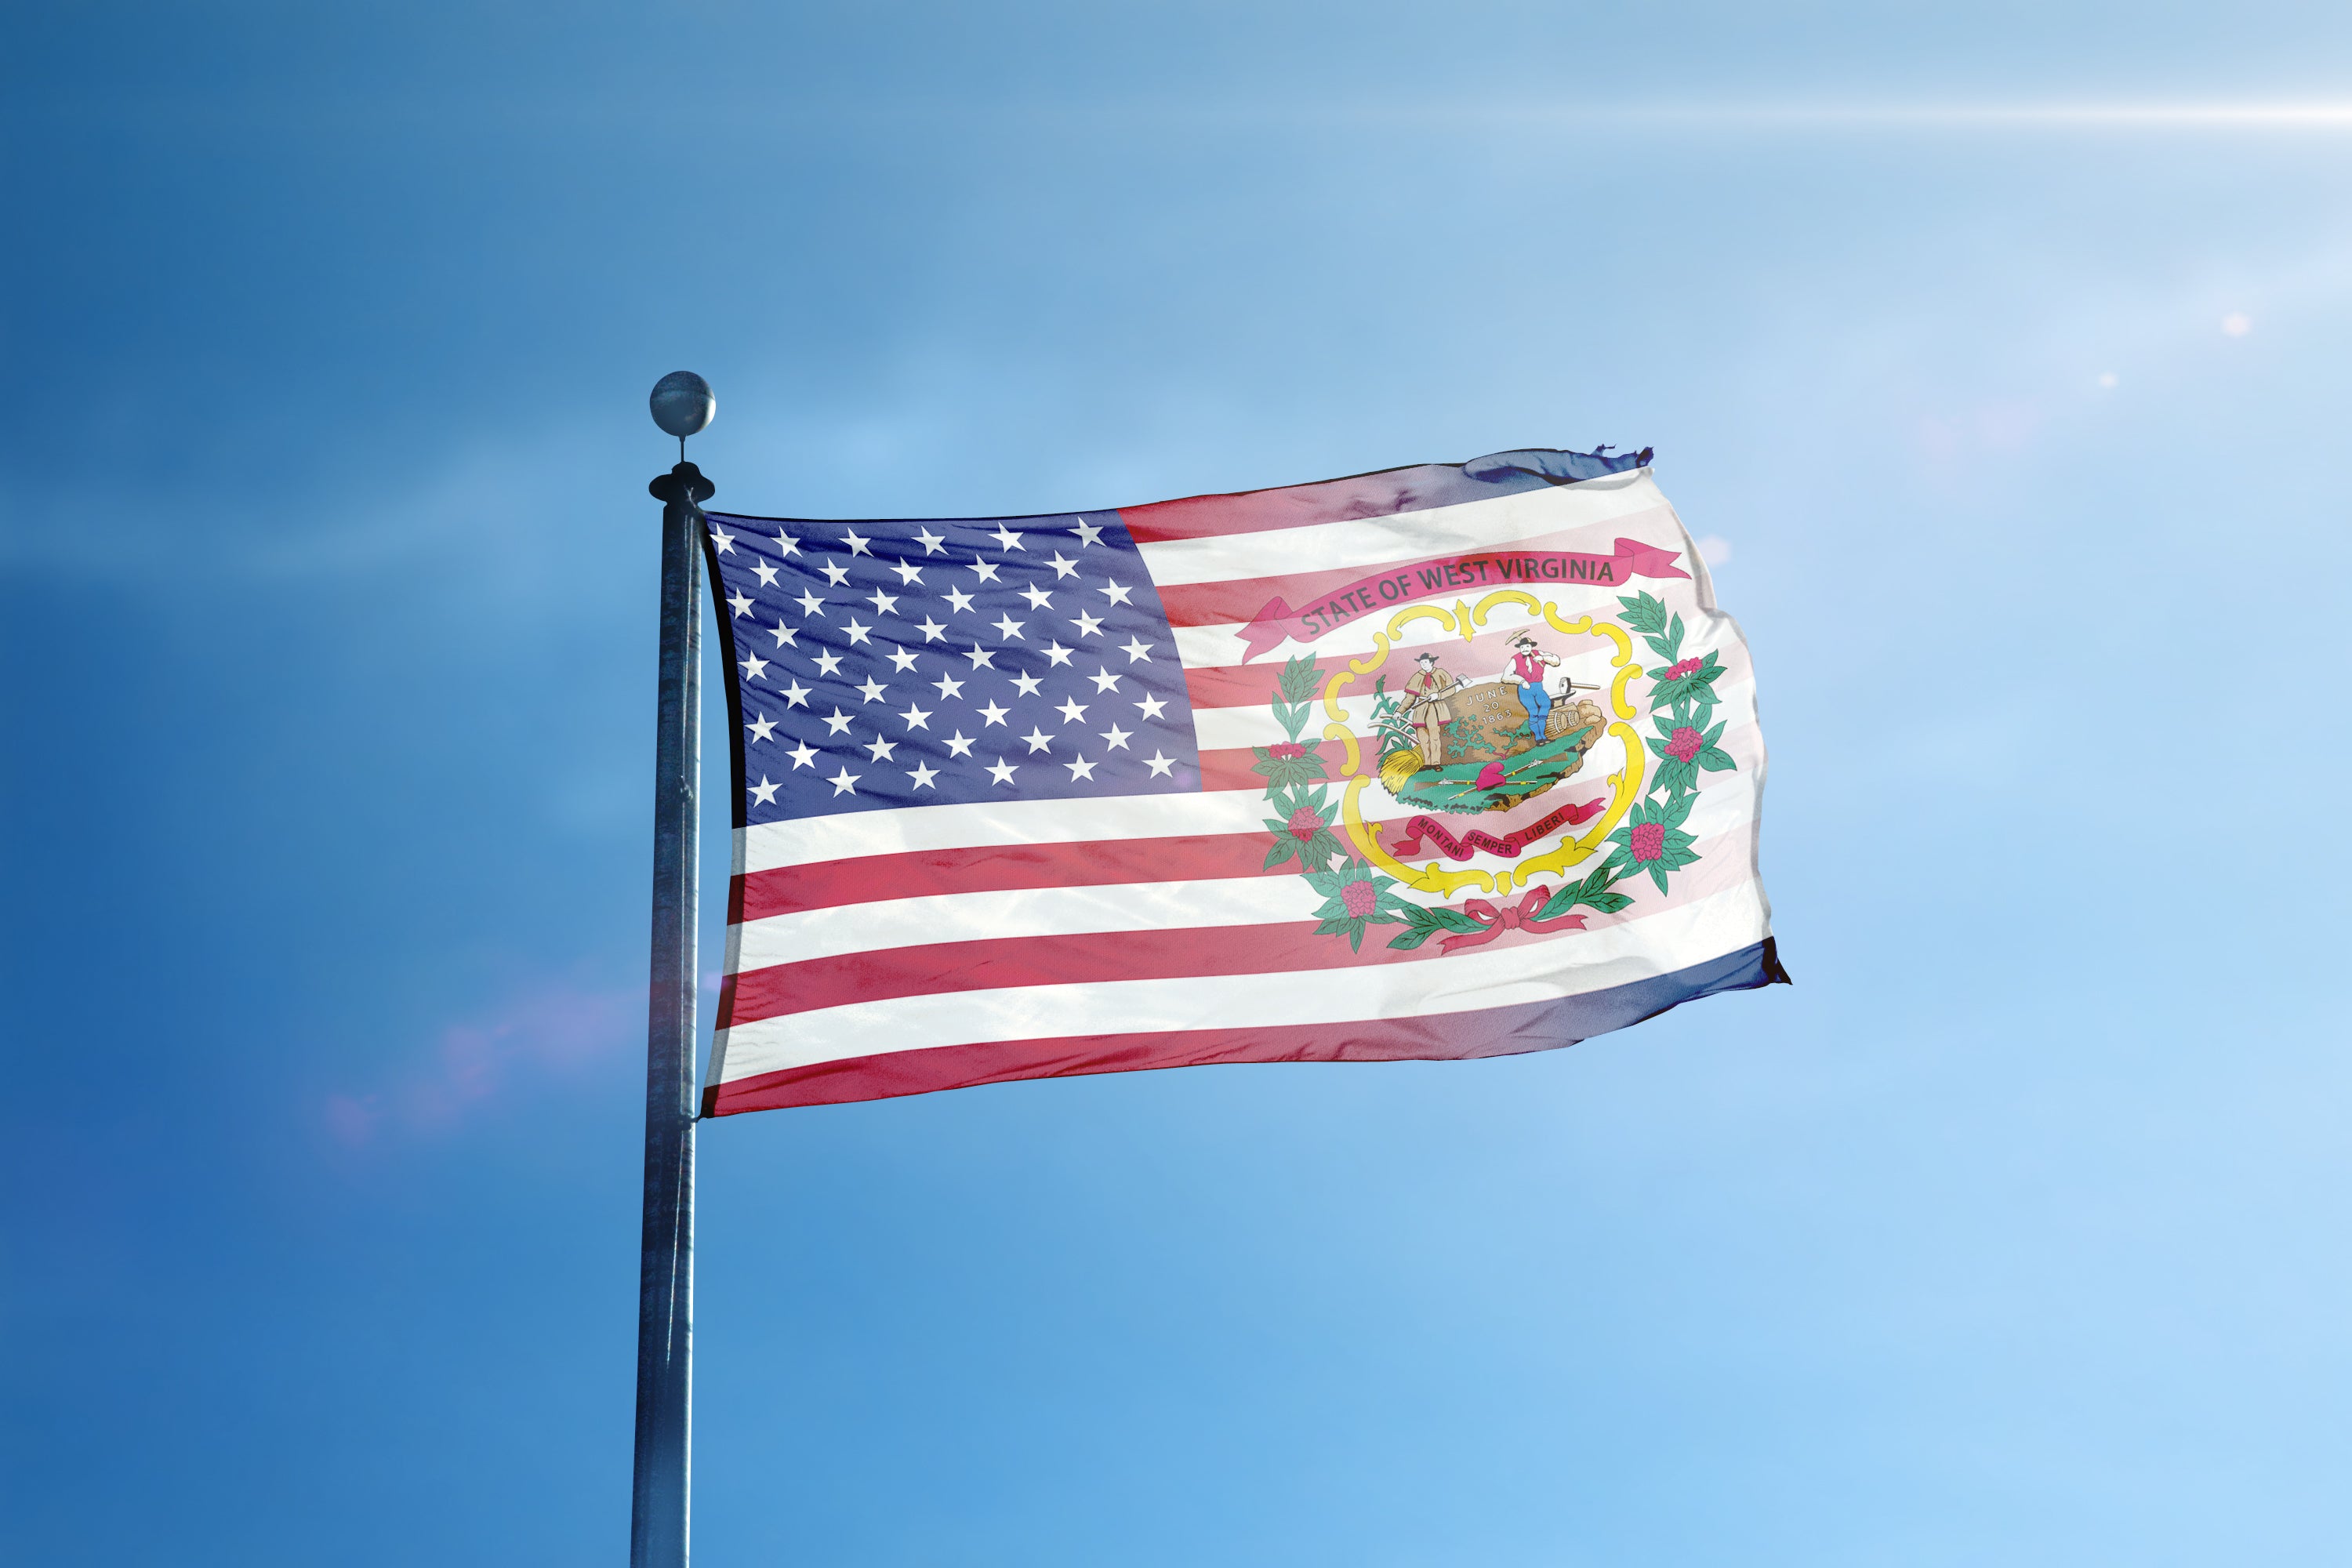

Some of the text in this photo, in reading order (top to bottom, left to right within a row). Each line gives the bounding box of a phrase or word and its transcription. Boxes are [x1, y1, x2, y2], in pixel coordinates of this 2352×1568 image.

[1301, 557, 1614, 635] STATE OF WEST VIRGINIA
[1467, 686, 1508, 706] JUNE
[1482, 710, 1512, 724] 1863
[1483, 702, 1499, 713] 20
[1417, 812, 1565, 858] MONTANI SEMPER LIBERI
